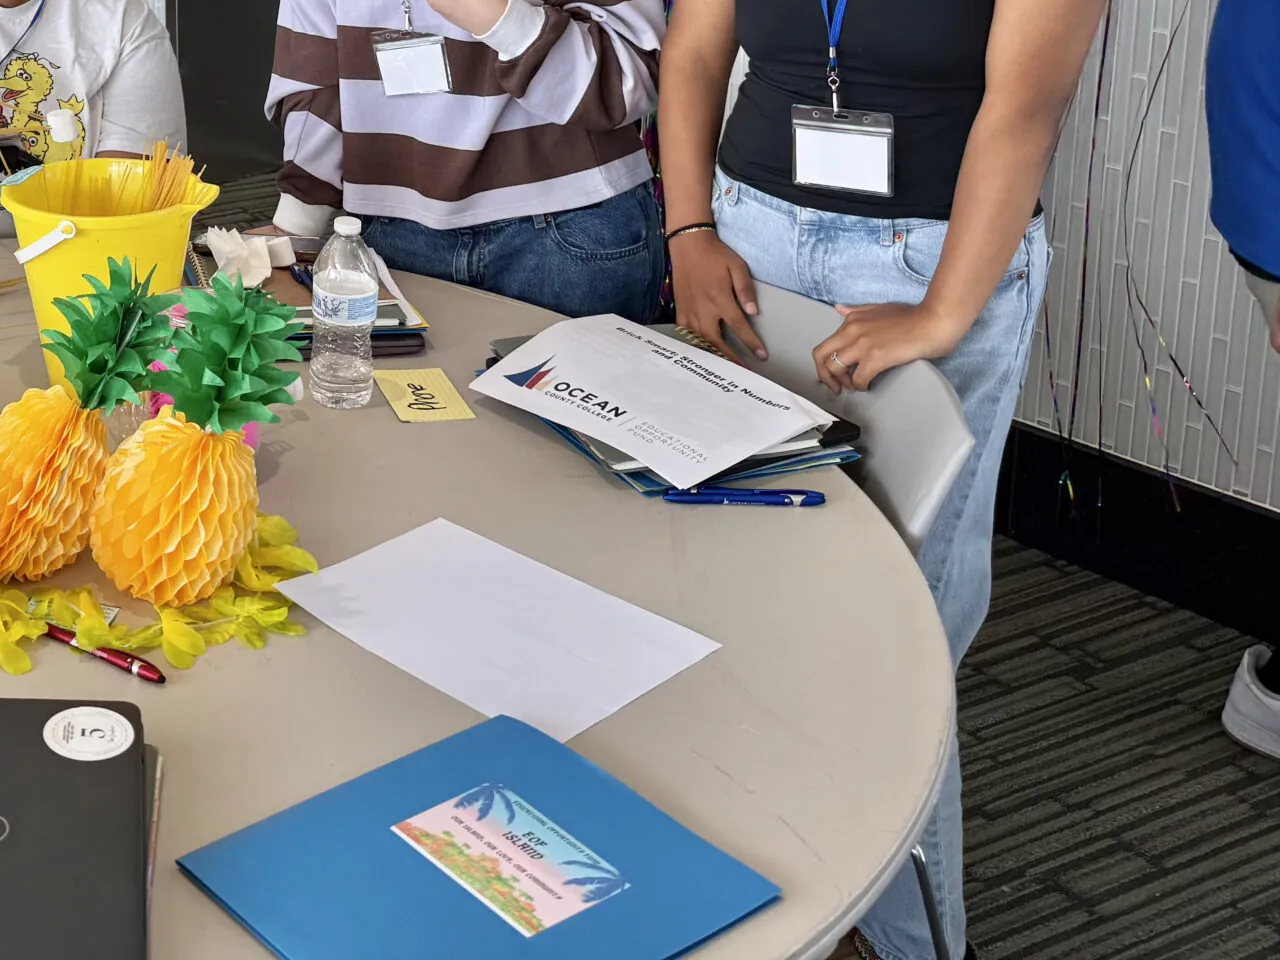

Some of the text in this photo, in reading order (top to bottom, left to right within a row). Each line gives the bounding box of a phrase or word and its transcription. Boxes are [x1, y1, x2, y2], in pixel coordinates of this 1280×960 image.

[616, 326, 791, 412] Brick Smart: Stronger in Numbers
[651, 348, 735, 394] and Community
[544, 390, 613, 422] COUNTY COLLEGE
[553, 381, 628, 419] OCEAN
[627, 428, 657, 445] FUND
[634, 424, 704, 465] OPPORTUNITY
[641, 421, 709, 462] EDUCATIONAL
[502, 830, 545, 861] ISLAND
[521, 830, 548, 848] EOF
